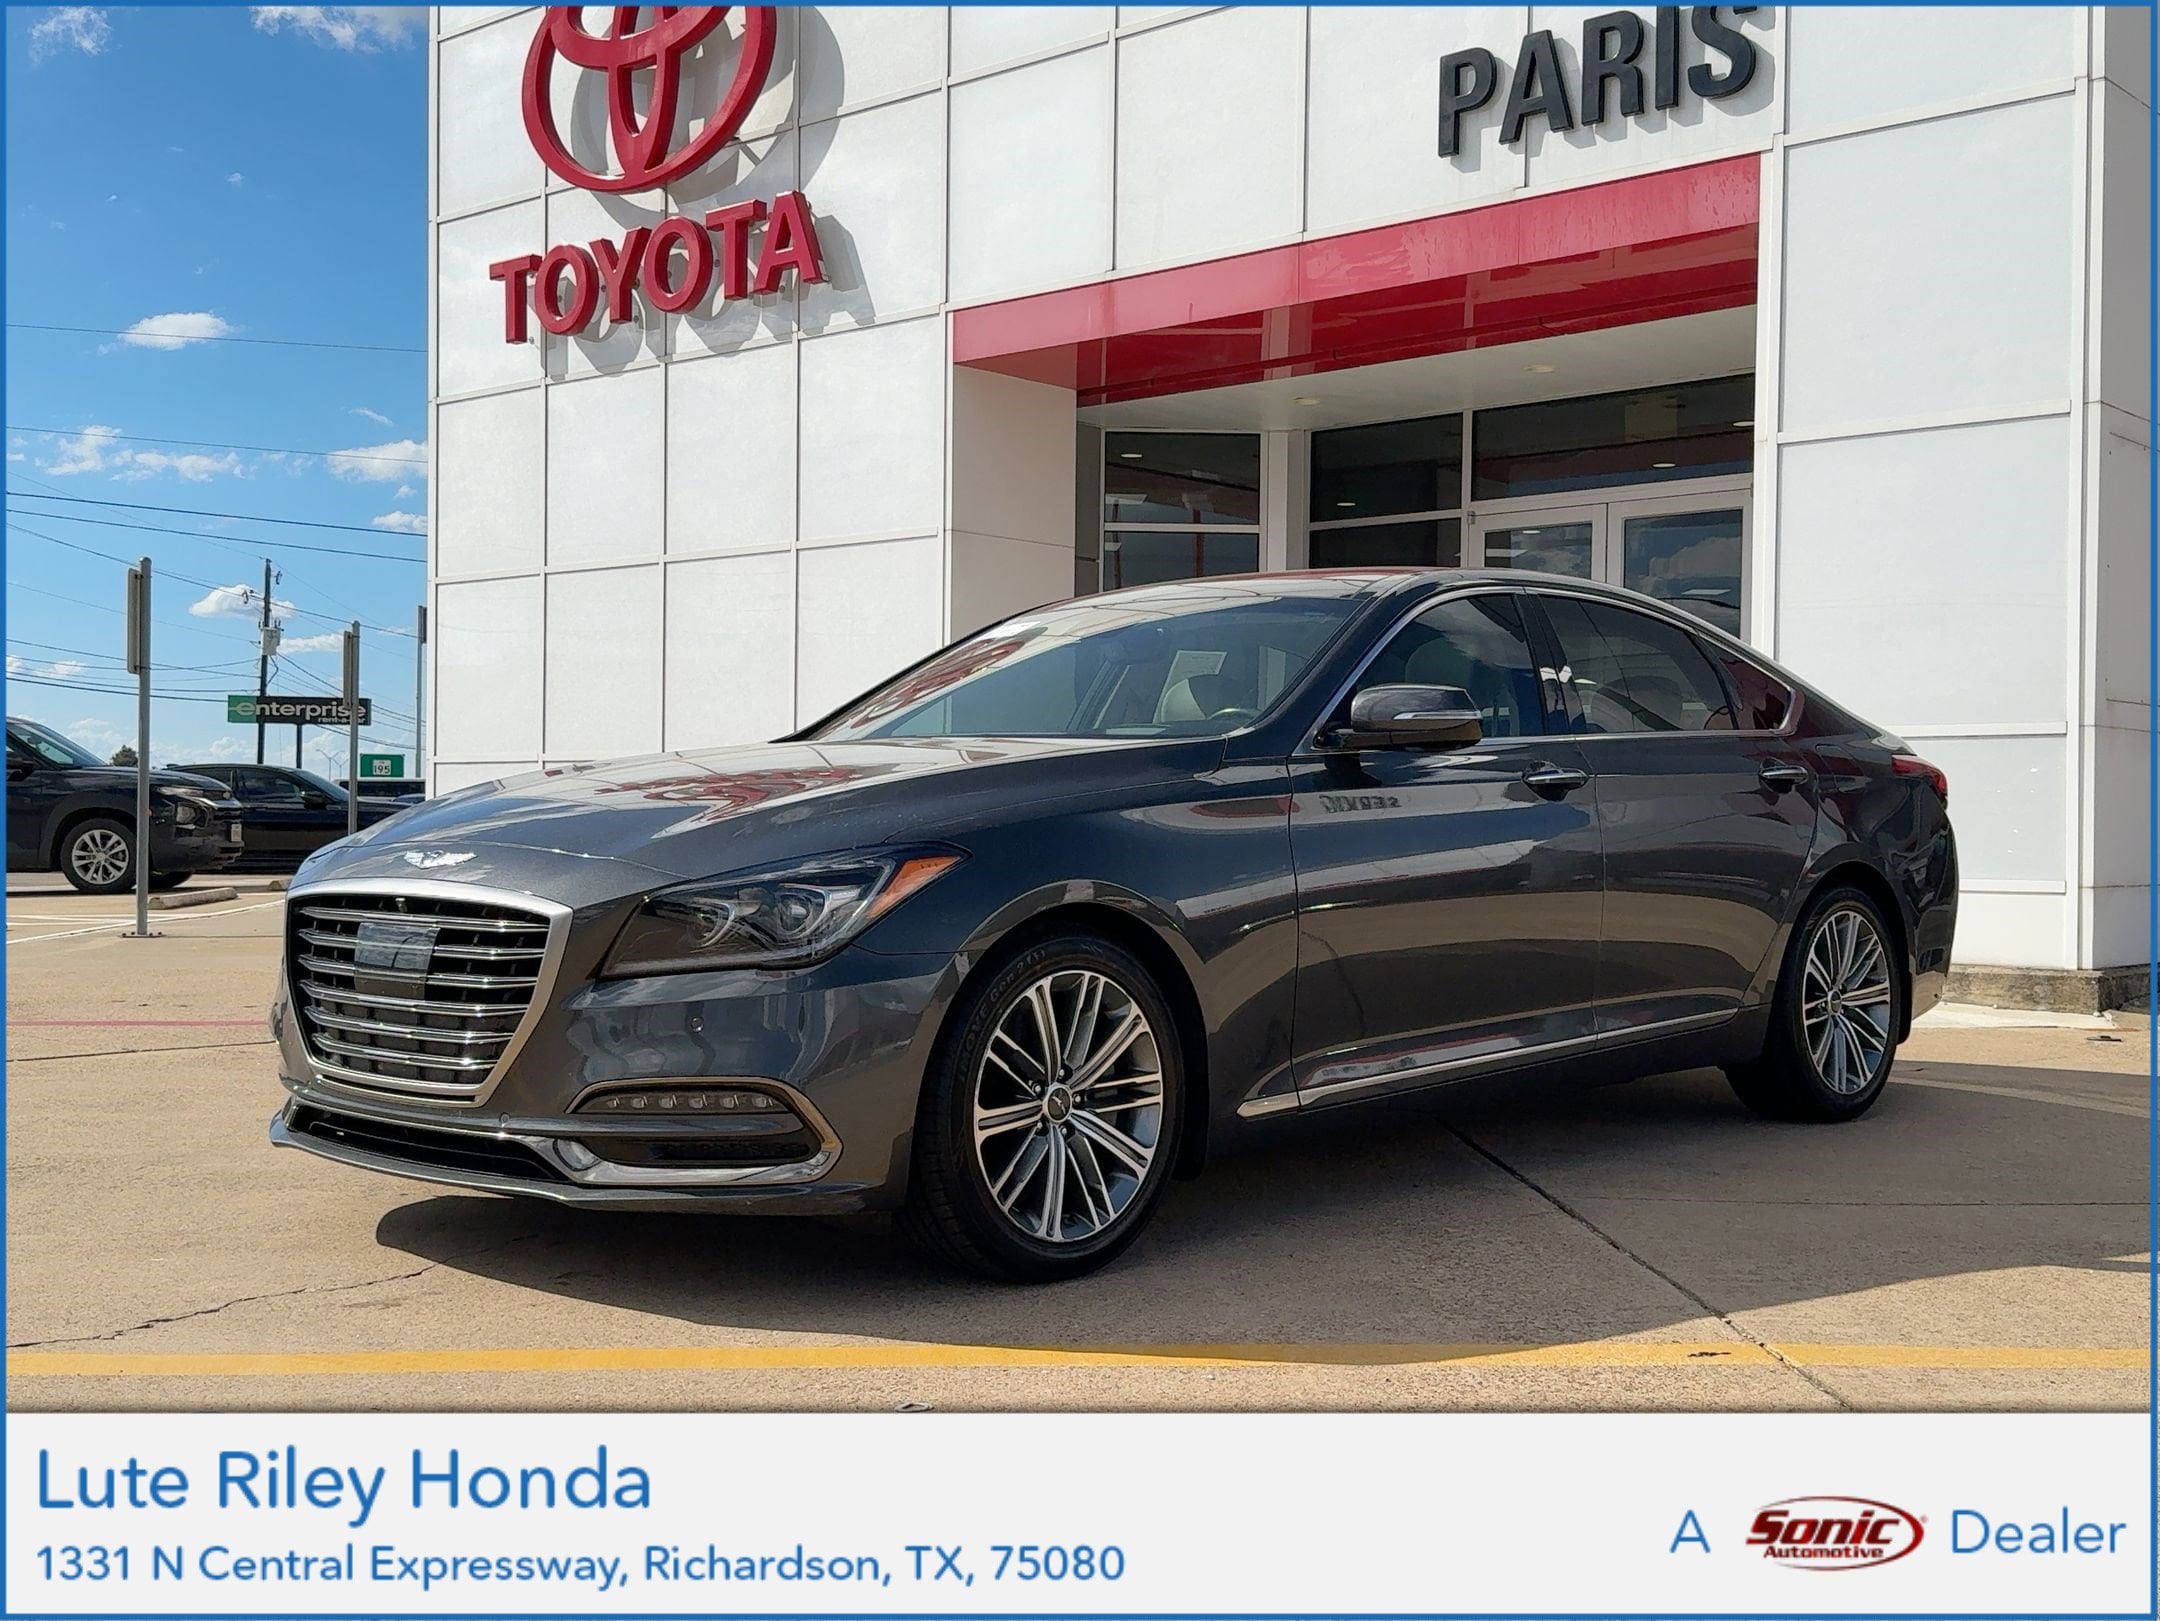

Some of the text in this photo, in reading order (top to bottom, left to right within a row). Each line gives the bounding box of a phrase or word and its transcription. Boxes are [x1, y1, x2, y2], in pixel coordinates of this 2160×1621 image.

[1438, 6, 1757, 158] PARIS
[489, 190, 829, 344] TOYOTA
[374, 764, 391, 775] 195
